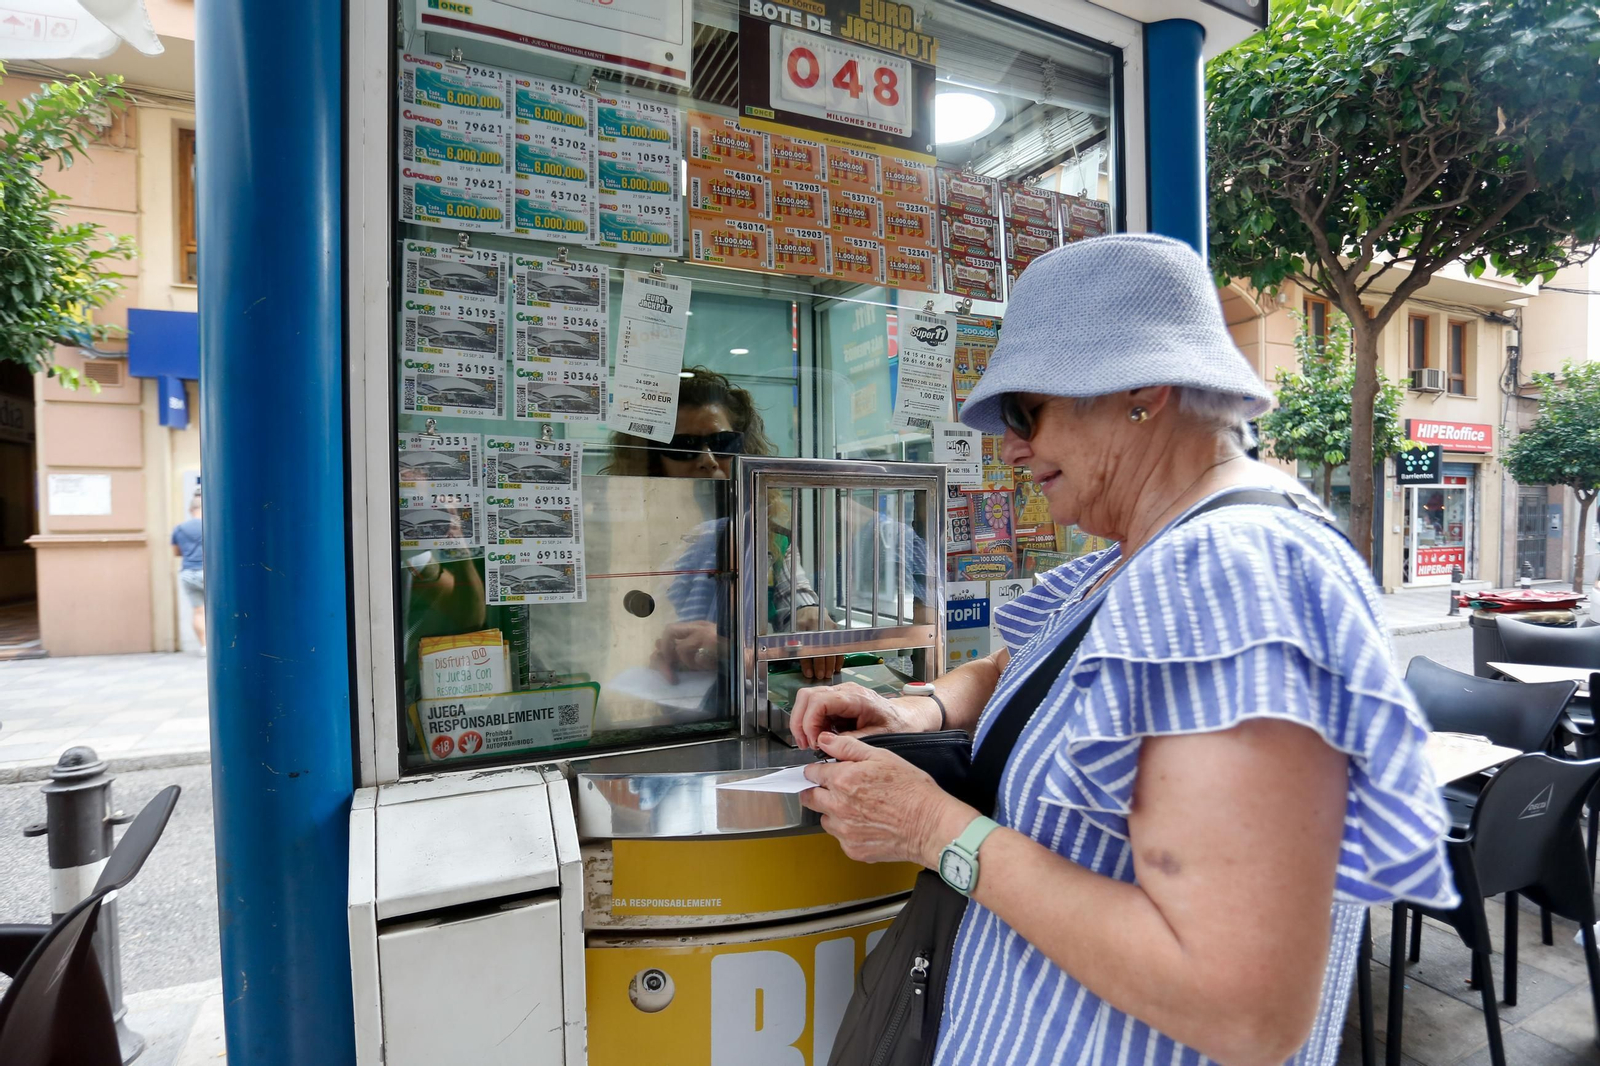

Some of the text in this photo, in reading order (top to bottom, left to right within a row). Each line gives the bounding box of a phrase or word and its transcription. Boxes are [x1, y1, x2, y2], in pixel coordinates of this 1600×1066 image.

[440, 4, 471, 14] ONCE
[792, 0, 823, 14] SORTEO
[750, 0, 832, 35] BOTE DE
[860, 0, 912, 30] EURO
[840, 16, 933, 60] JACKPOT
[532, 40, 549, 48] JUEGA
[550, 44, 606, 60] RESPONSABLEMENTE
[465, 66, 502, 80] 79621
[637, 102, 668, 114] 10593
[754, 108, 773, 118] ONCE
[465, 122, 502, 134] 79621
[826, 112, 864, 126] MILLONES
[879, 124, 903, 134] EUROS
[550, 136, 586, 150] 43702
[422, 158, 440, 166] ONCE
[638, 152, 670, 164] 10593
[735, 172, 762, 183] 48014
[970, 176, 990, 184] 3590
[465, 178, 502, 190] 79621
[795, 182, 820, 192] 12903
[551, 190, 586, 202] 43702
[852, 194, 875, 204] 83712
[638, 204, 670, 216] 10593
[906, 205, 928, 214] 32341
[972, 216, 992, 226] 33590
[737, 222, 764, 232] 48014
[797, 230, 822, 238] 12903
[854, 240, 877, 249] 83712
[908, 248, 930, 258] 32341
[564, 263, 598, 274] 0346
[974, 258, 994, 268] 33590
[646, 293, 667, 304] EURO
[458, 306, 496, 318] 36195
[638, 299, 673, 314] JACKPOT
[564, 316, 598, 327] 50346
[457, 363, 494, 375] 36195
[564, 371, 598, 382] 50346
[642, 392, 672, 404] 2,00 EUR
[920, 392, 944, 401] 1,00 EUR
[1417, 424, 1485, 442] HIPERoffice
[946, 440, 956, 450] MI
[956, 442, 971, 454] DÍA
[432, 494, 470, 504] 70351
[535, 496, 570, 505] 69183
[536, 550, 572, 560] 69183
[998, 586, 1008, 596] MI
[437, 682, 493, 696] RESPONSABILIDAD
[428, 704, 466, 720] JUEGA
[430, 708, 554, 734] RESPONSABLEMENTE
[486, 729, 512, 737] Prohibida
[434, 740, 450, 754] +18
[486, 738, 534, 750] AUTOPROHIBIDOS
[630, 898, 722, 908] RESPONSABLEMENTE
